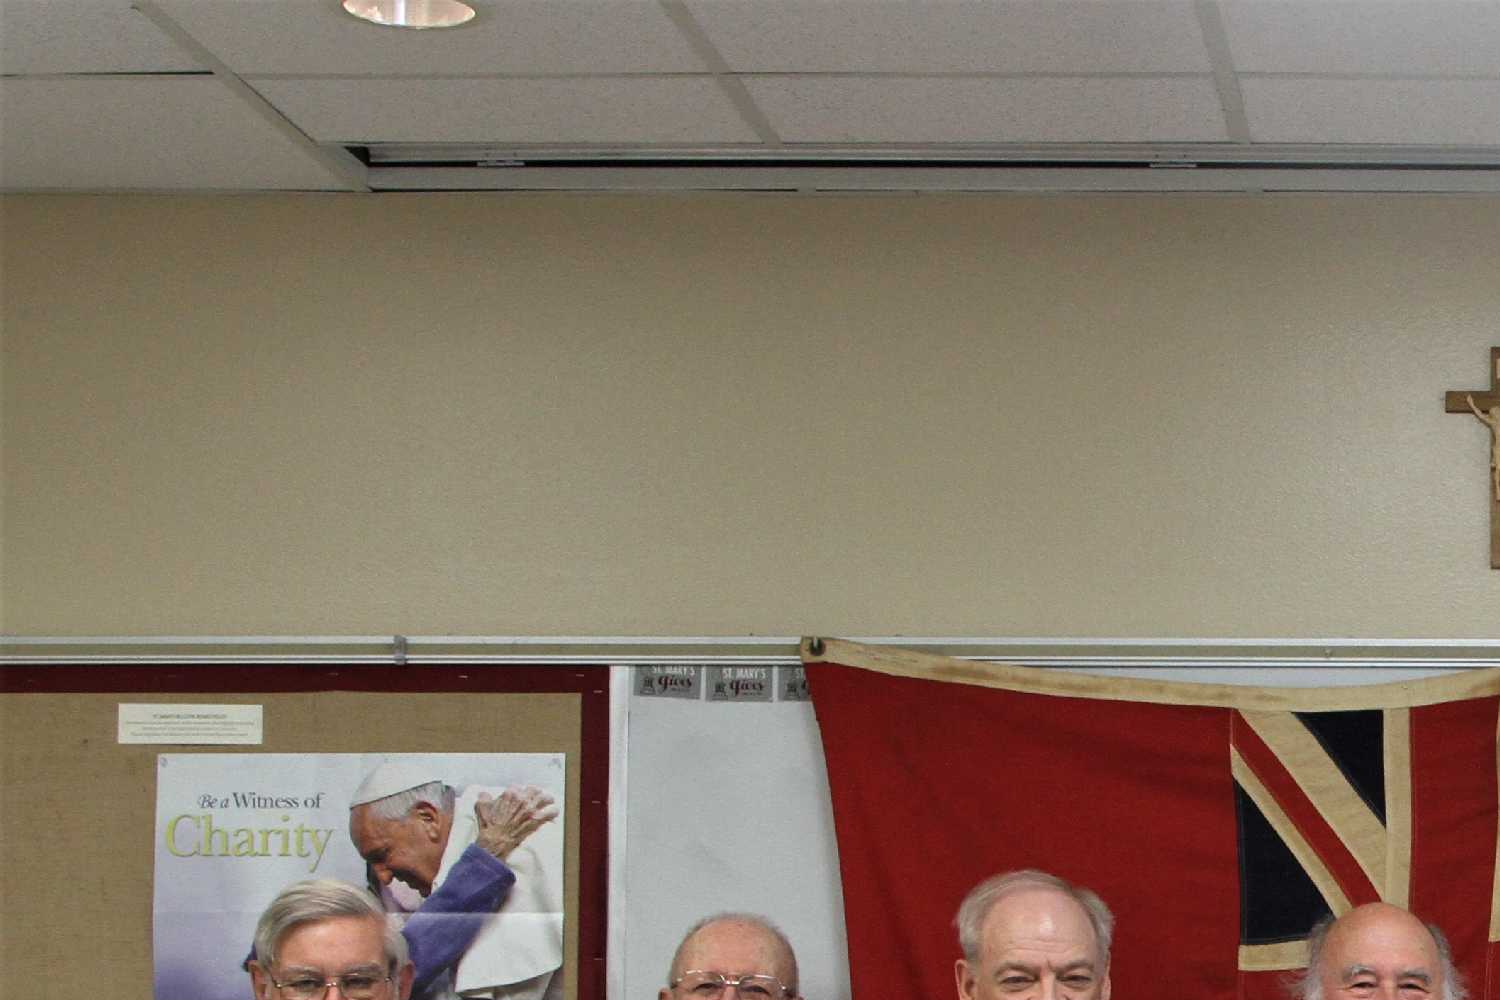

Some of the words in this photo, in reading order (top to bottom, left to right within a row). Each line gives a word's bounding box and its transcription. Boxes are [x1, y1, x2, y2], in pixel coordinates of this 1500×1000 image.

[736, 668, 767, 679] MARY'S
[199, 793, 218, 808] Be
[220, 797, 229, 808] a
[233, 792, 299, 808] Witness
[304, 792, 324, 808] of
[166, 814, 335, 873] Charity
